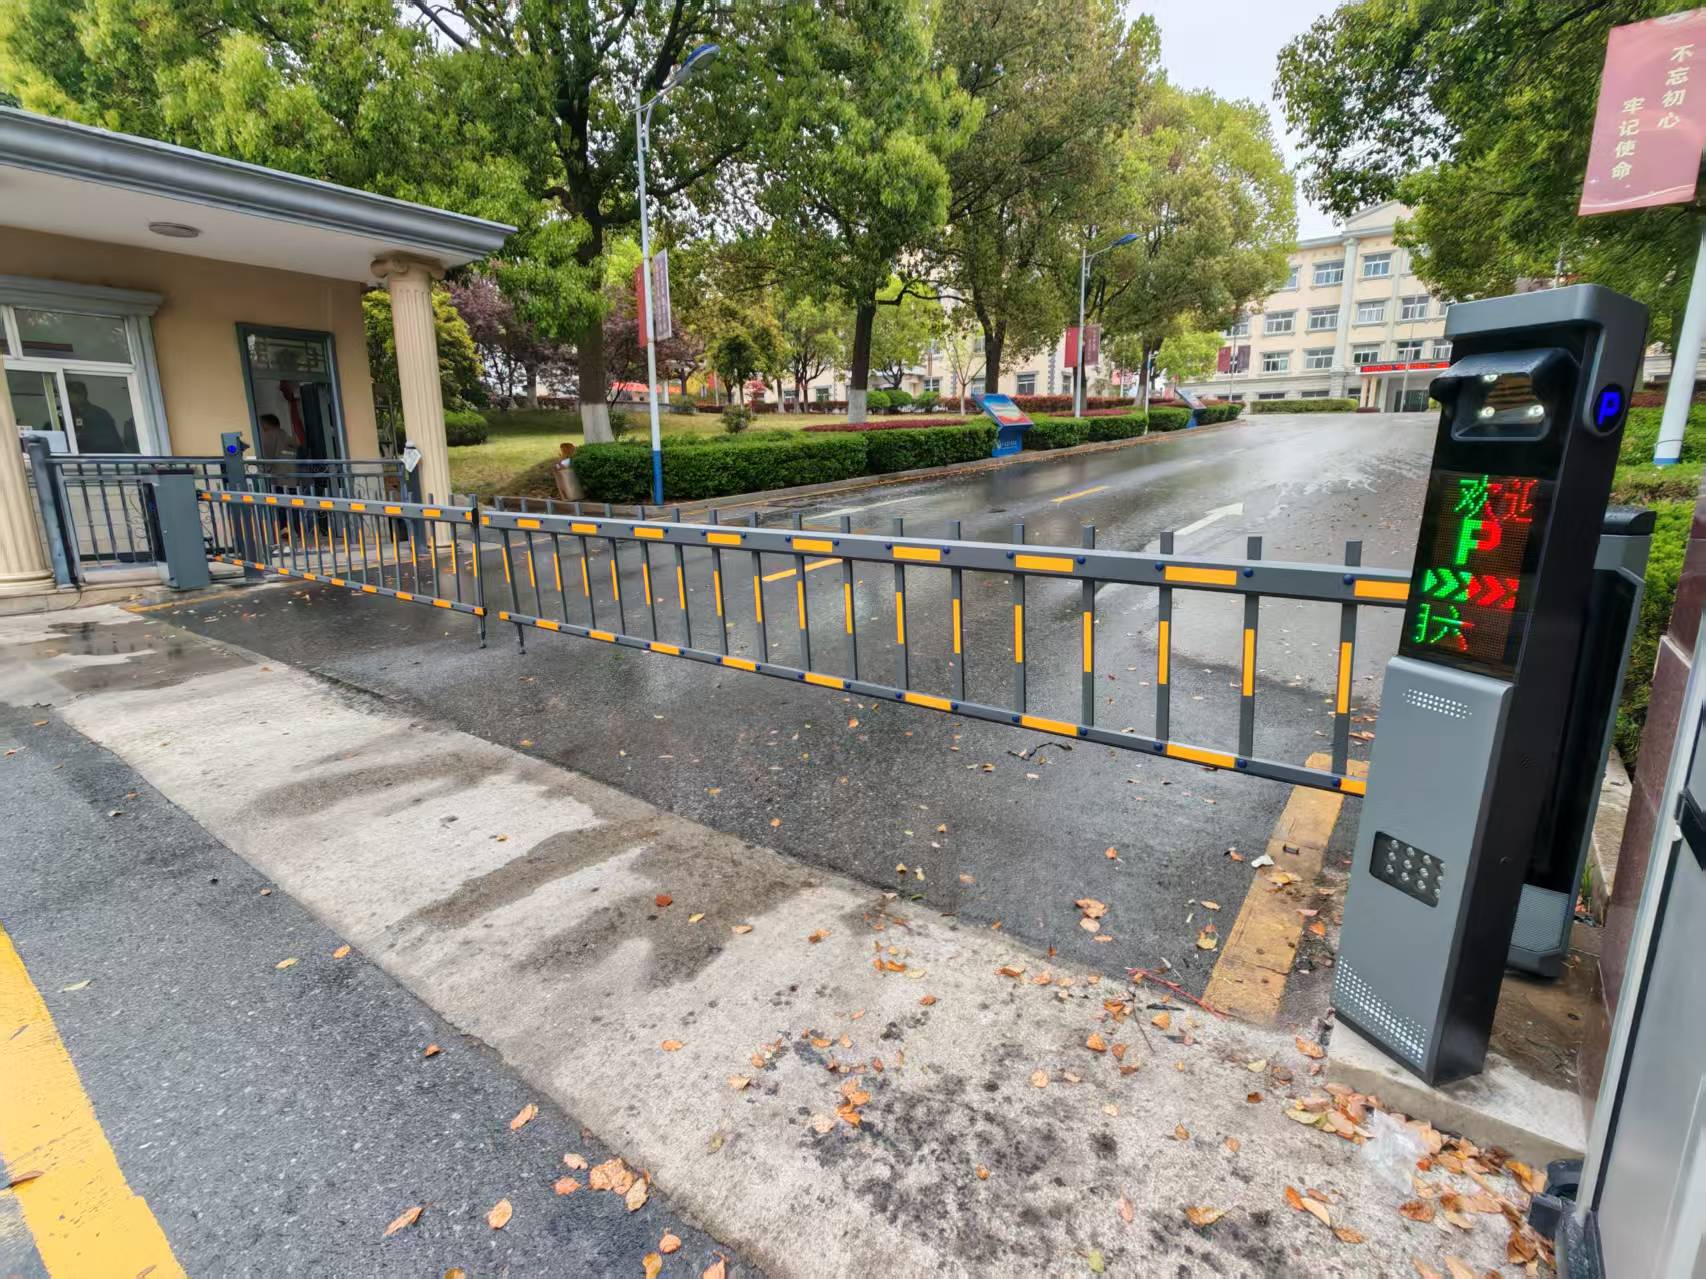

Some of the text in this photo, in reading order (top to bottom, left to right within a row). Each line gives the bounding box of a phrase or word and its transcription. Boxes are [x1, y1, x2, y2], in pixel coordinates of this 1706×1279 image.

[1657, 43, 1695, 129] 不忘初心
[1611, 96, 1646, 181] 牢记使命
[1597, 391, 1621, 426] P
[1454, 519, 1502, 566] P
